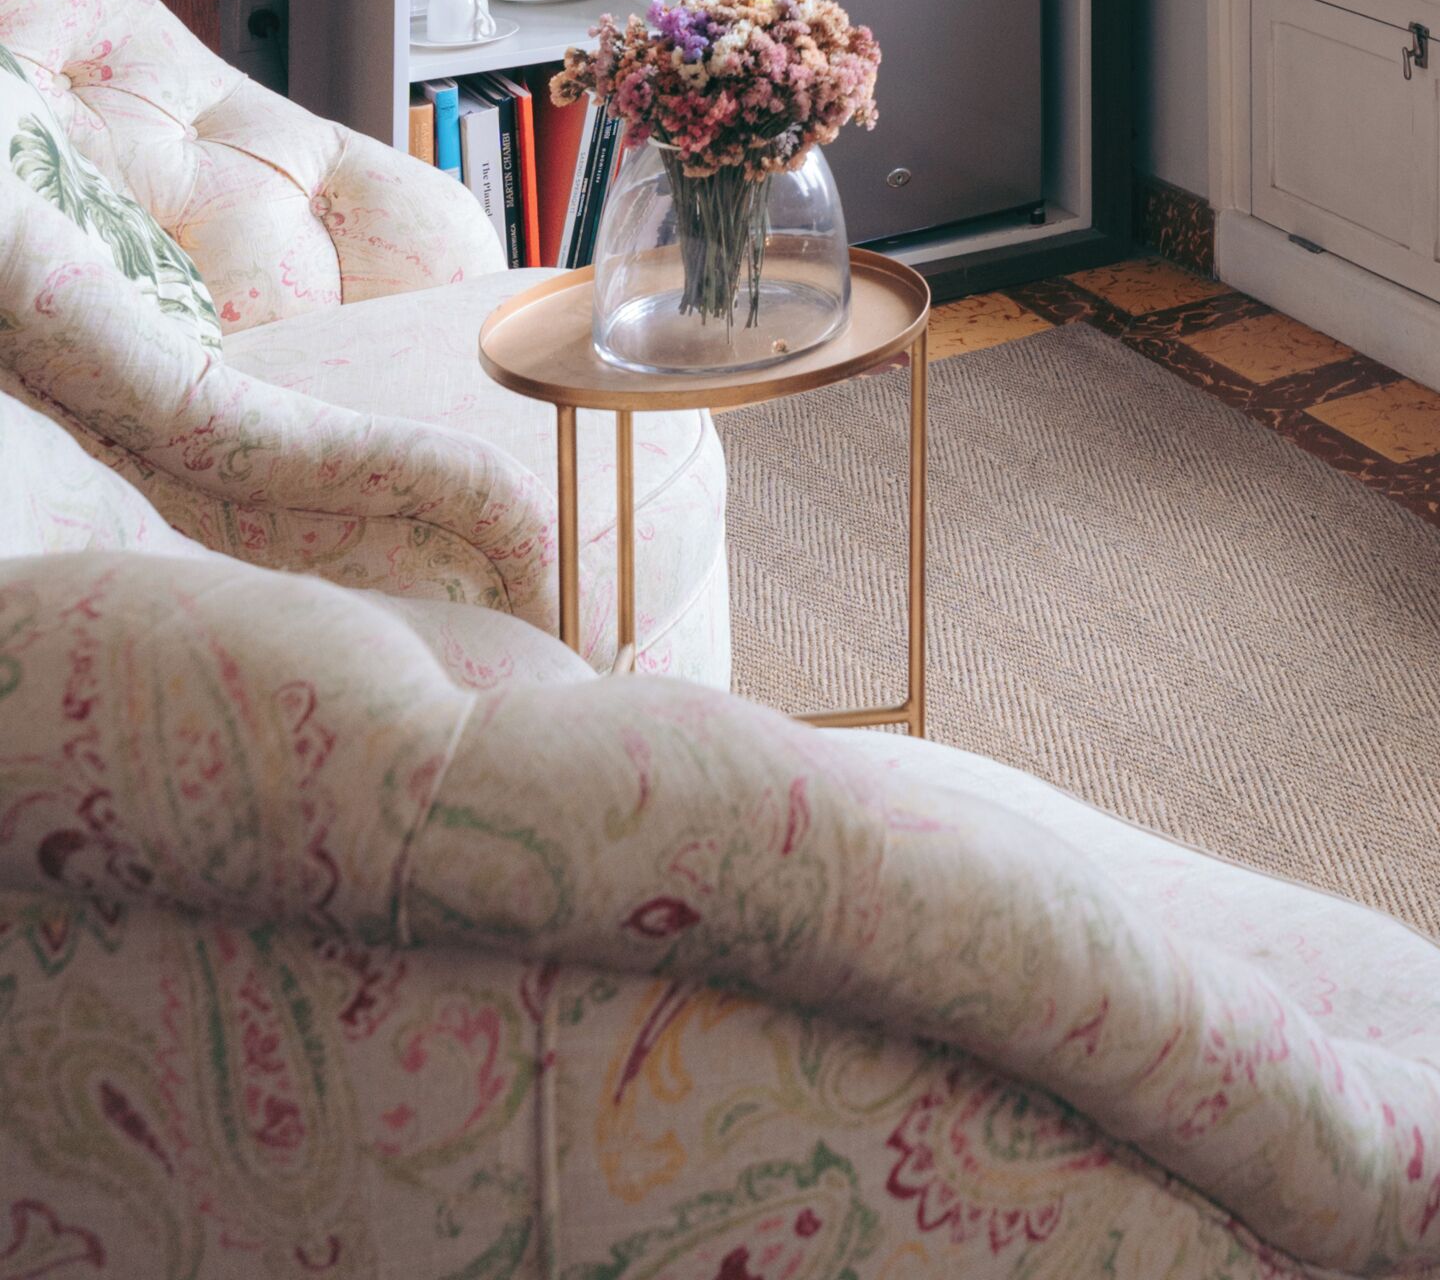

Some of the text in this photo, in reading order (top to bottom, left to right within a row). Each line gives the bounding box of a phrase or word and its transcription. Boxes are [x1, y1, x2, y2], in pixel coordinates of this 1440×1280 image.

[482, 162, 490, 180] The
[502, 132, 514, 208] MARTIN CHAMBI
